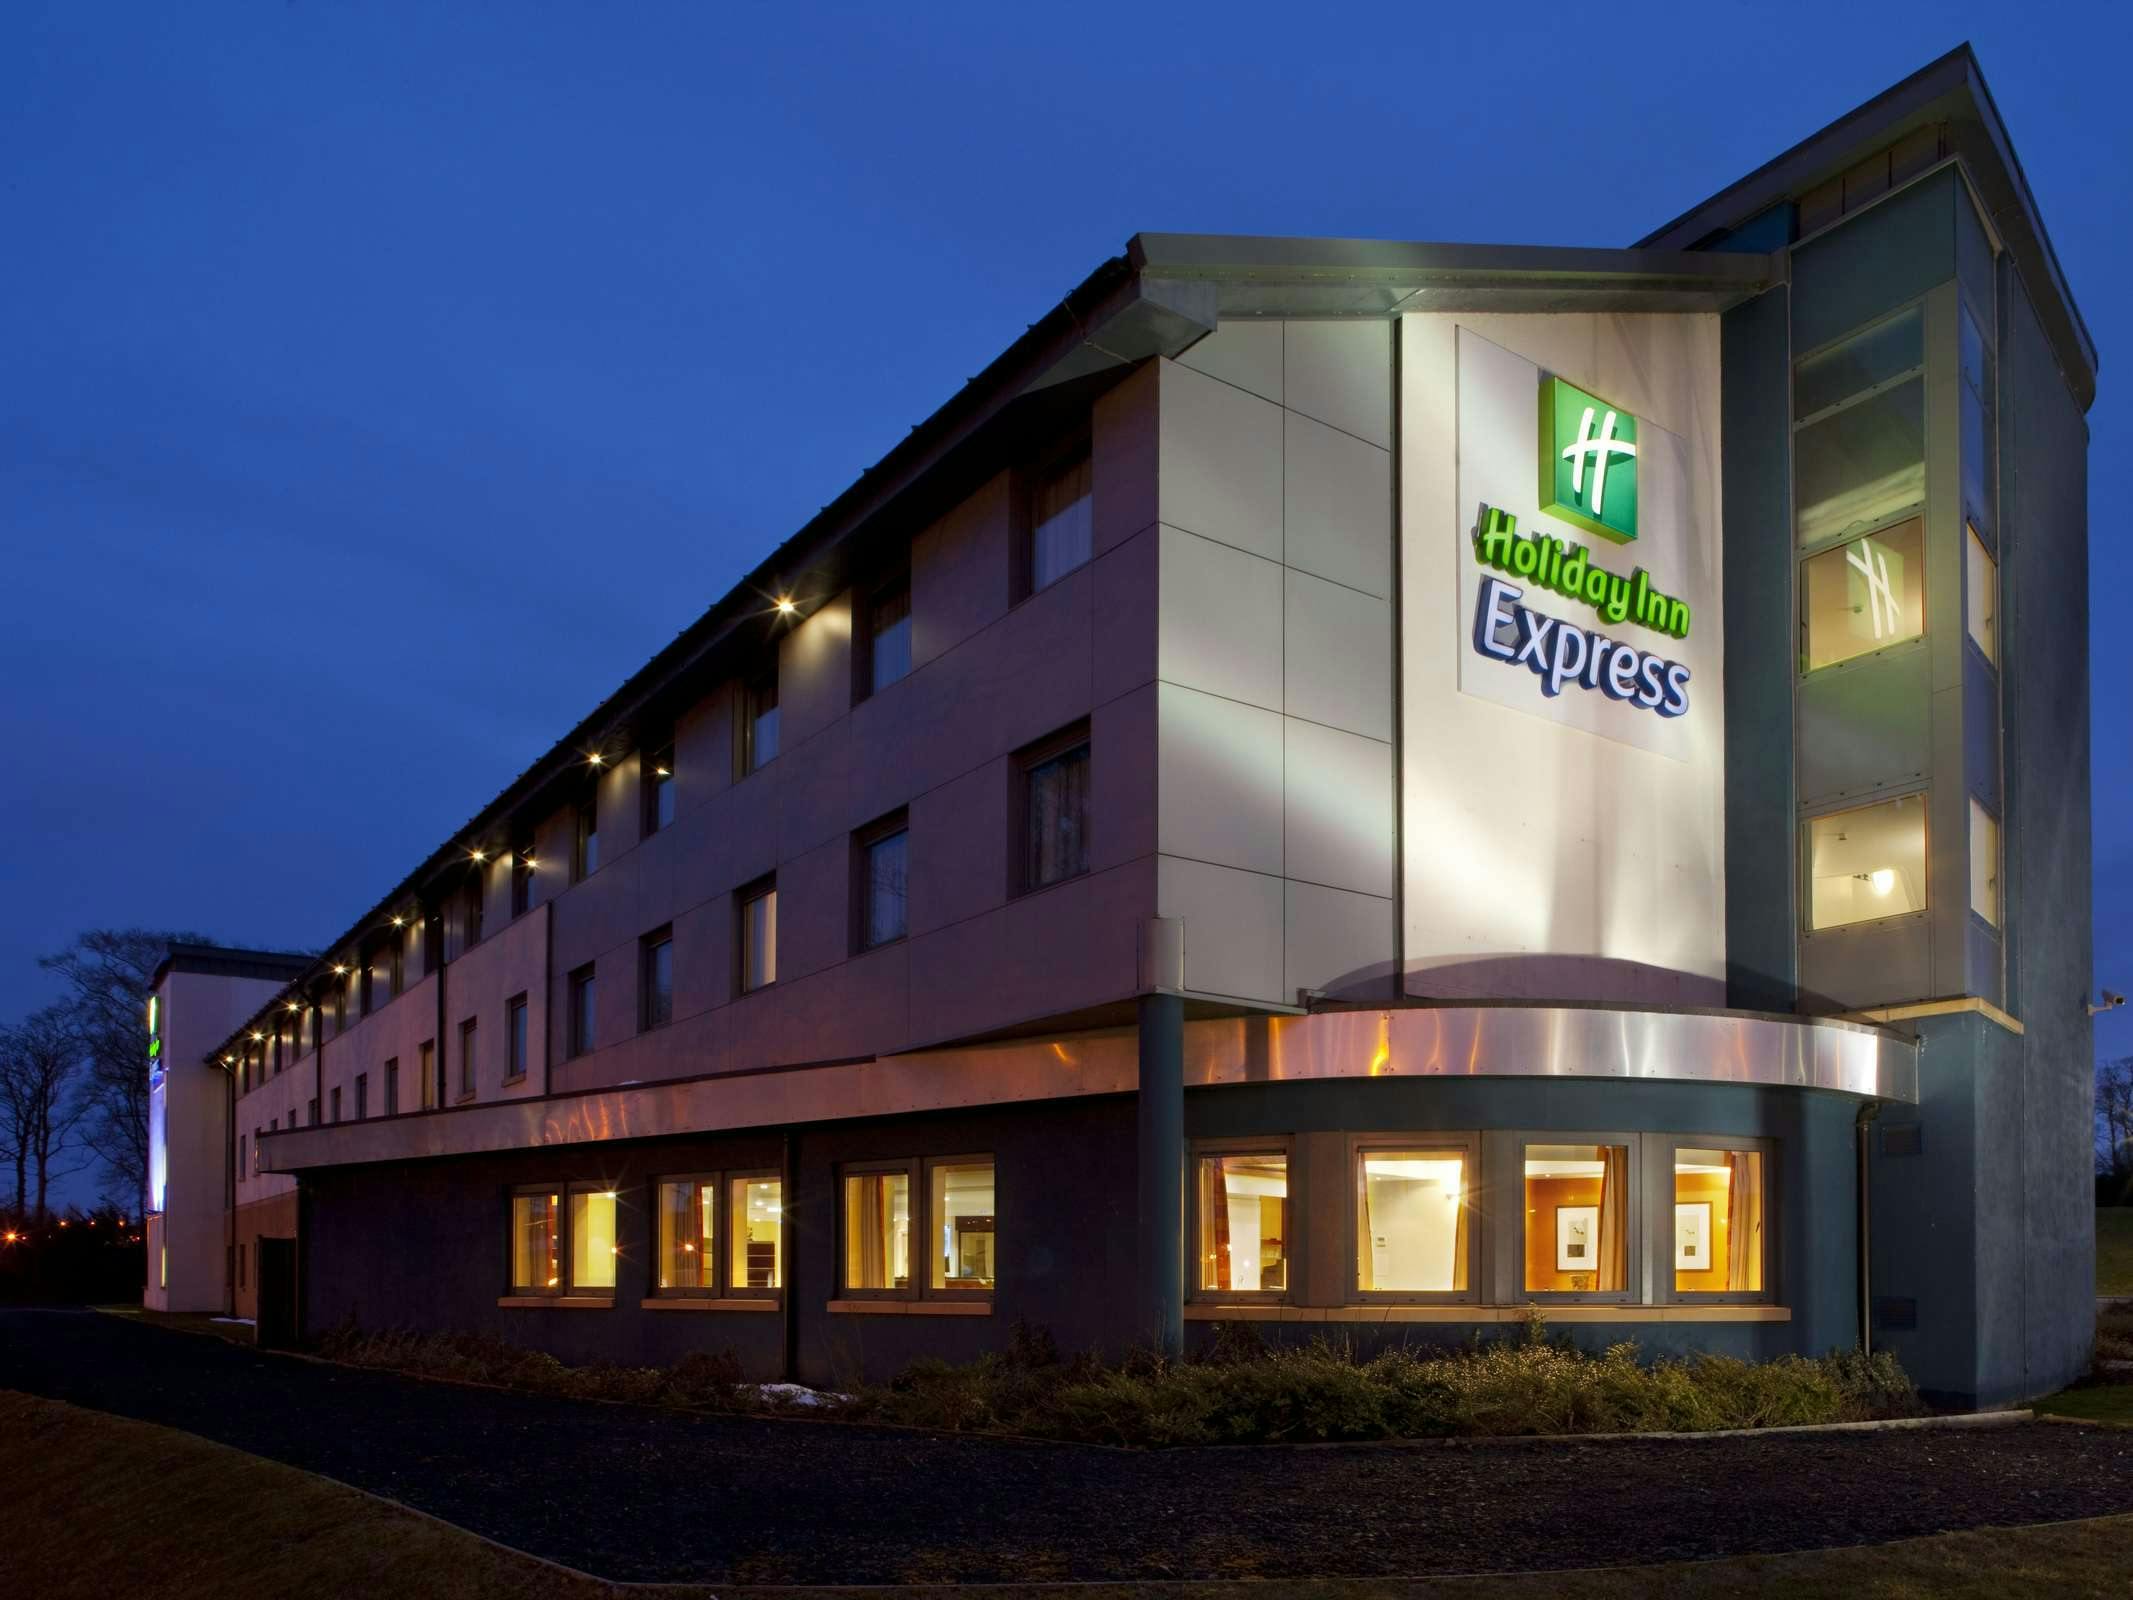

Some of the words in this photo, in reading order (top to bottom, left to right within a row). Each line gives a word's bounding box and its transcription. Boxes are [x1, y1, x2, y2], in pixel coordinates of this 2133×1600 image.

[1480, 505, 1632, 623] Holiday
[1635, 568, 1691, 638] Inn
[1477, 577, 1692, 717] Express
